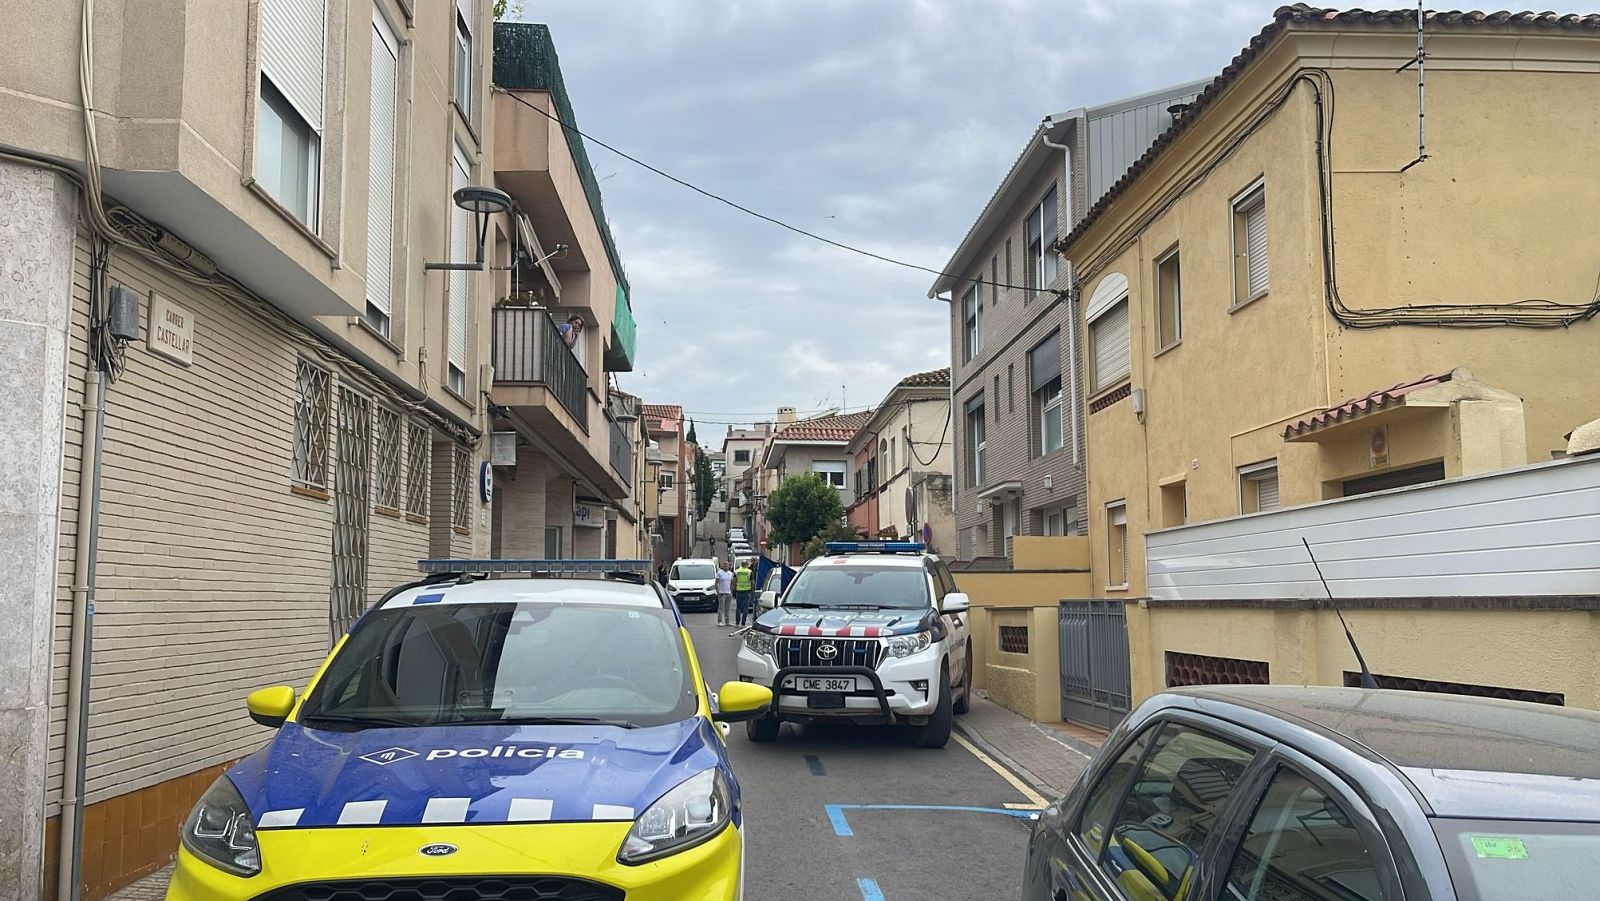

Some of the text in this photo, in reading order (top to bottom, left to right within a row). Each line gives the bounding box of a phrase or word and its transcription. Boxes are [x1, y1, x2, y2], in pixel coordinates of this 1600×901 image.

[166, 309, 184, 329] CARRER
[157, 325, 190, 354] CASTELLAR
[803, 679, 849, 690] CME 3847
[426, 746, 585, 761] policia
